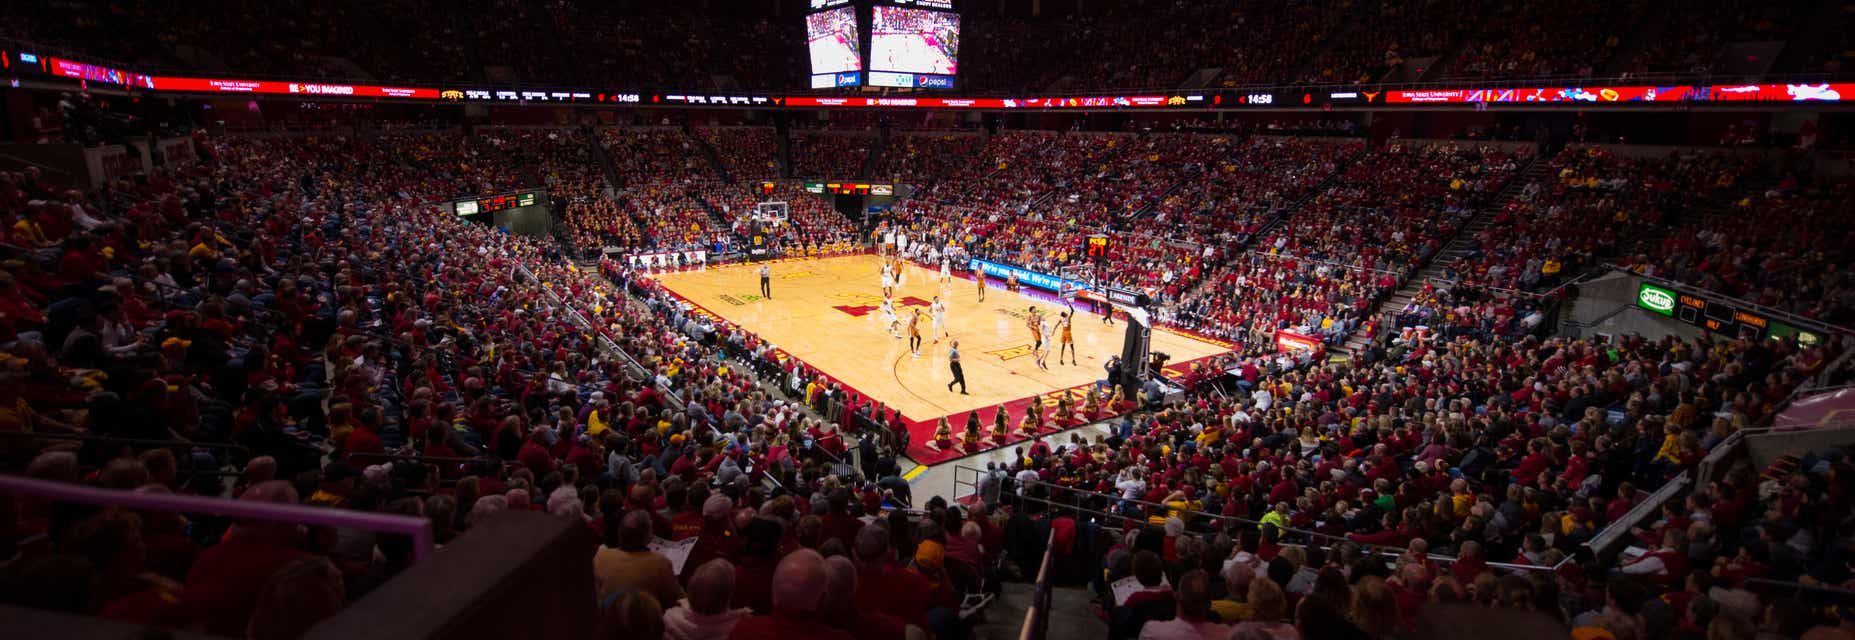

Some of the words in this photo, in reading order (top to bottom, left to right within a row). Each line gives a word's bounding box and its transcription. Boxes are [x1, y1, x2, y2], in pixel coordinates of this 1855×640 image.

[928, 78, 947, 88] pepsi
[617, 94, 640, 102] 14:58
[1247, 94, 1271, 104] 14:58
[1680, 295, 1705, 309] CYCLONES
